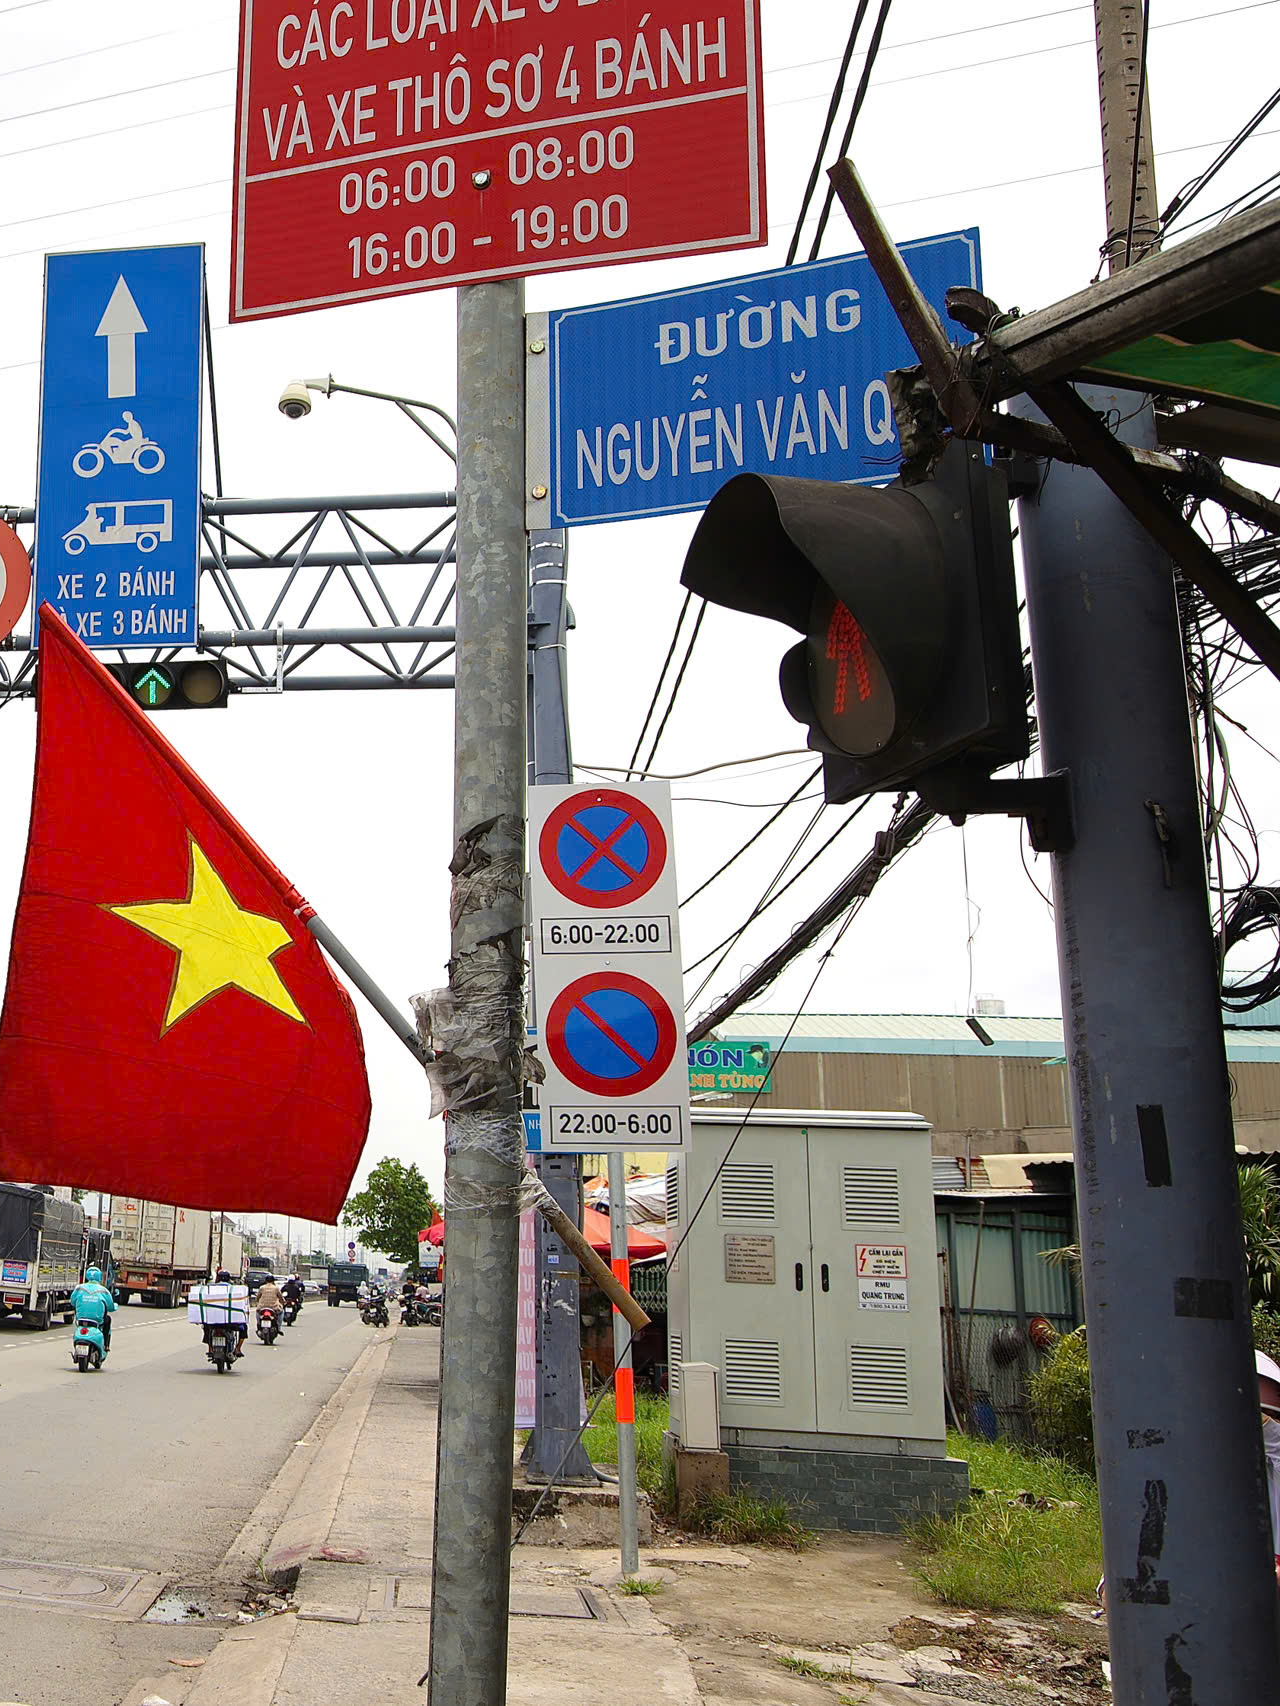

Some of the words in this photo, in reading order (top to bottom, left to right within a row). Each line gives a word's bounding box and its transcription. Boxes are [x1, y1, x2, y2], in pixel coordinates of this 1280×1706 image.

[277, 0, 354, 69] CÁC
[262, 86, 314, 160] VÀ
[325, 85, 377, 151] XE
[387, 53, 472, 137] THÔ
[485, 44, 544, 118] SƠ
[555, 45, 581, 105] 4
[596, 13, 727, 99] BÁNH
[338, 155, 456, 214] 06:00
[508, 125, 634, 185] 08:00
[347, 221, 457, 279] 16:00
[511, 194, 630, 252] 19:00
[654, 288, 862, 366] ĐƯỜNG
[576, 373, 745, 489] NGUYỄN
[756, 370, 849, 462] VĂN
[863, 379, 895, 446] Q
[57, 574, 84, 600] XE
[95, 573, 107, 598] 2
[119, 566, 175, 597] BÁNH
[76, 611, 102, 637] XE
[112, 610, 125, 636] 3
[131, 604, 187, 635] BÁNH
[550, 923, 660, 945] 6:00-22:00
[559, 1113, 672, 1135] 22:00-6:00
[861, 1291, 883, 1300] QUANG
[884, 1292, 905, 1300] TRUNG
